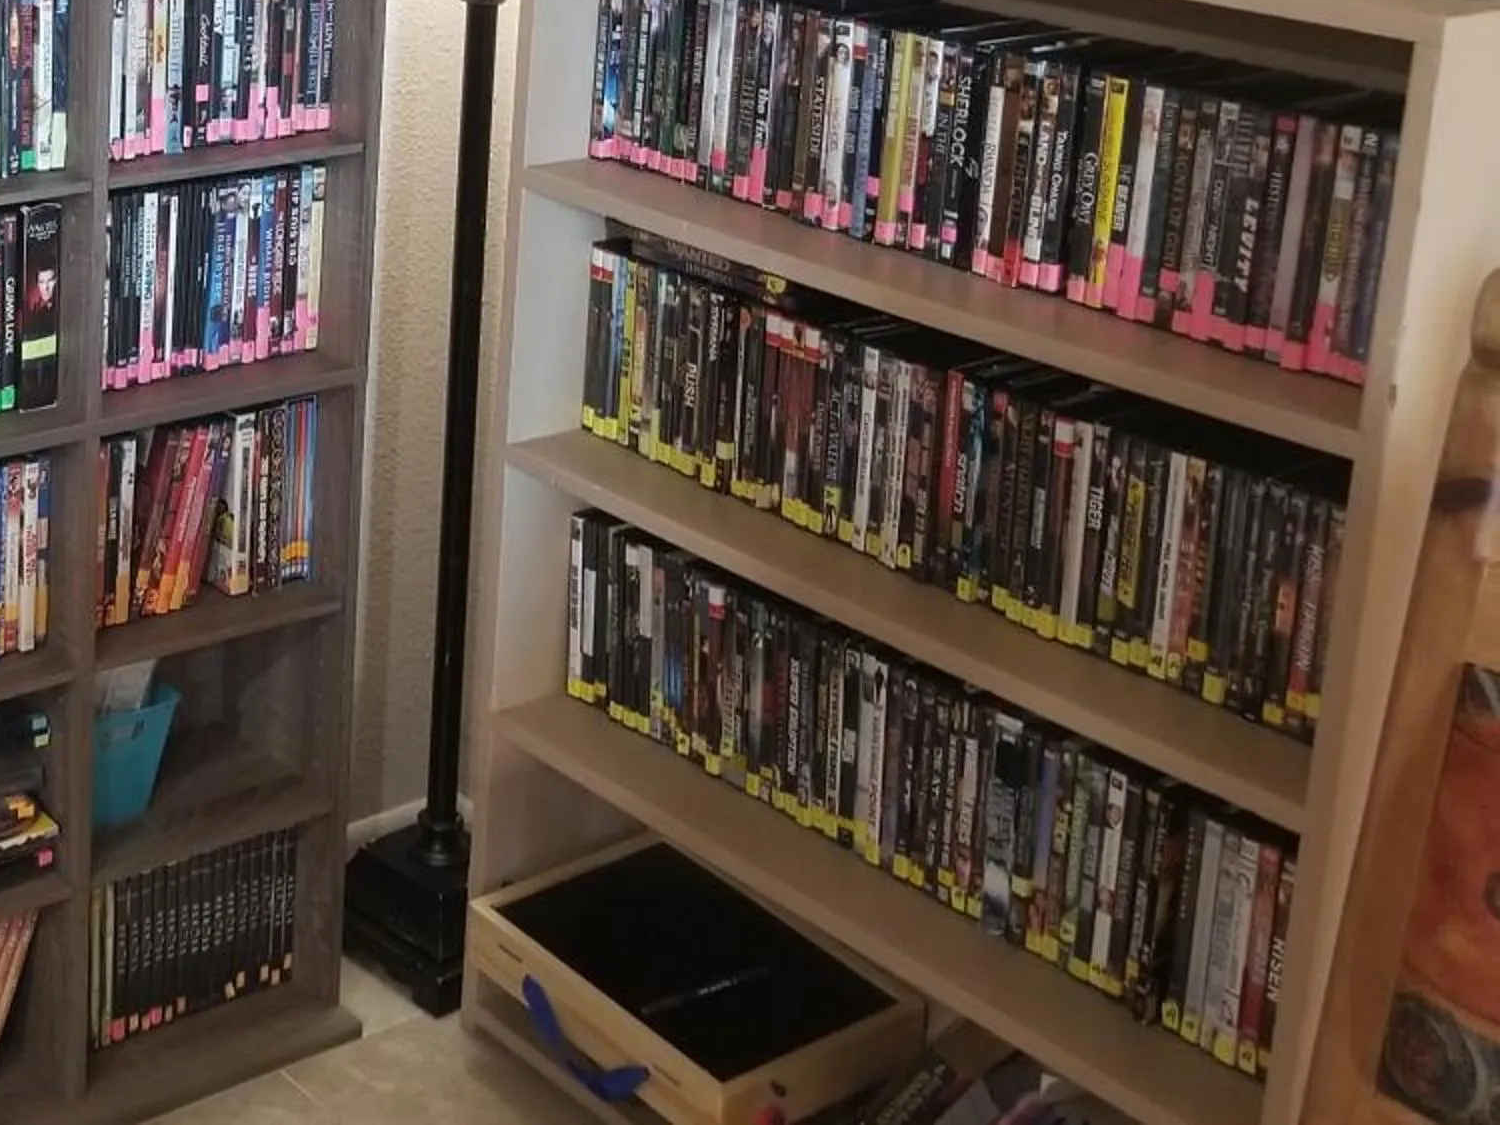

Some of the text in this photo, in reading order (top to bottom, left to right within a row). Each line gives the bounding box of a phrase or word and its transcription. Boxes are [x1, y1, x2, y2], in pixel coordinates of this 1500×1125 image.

[755, 87, 770, 114] the
[809, 75, 825, 158] STATESIDE
[950, 75, 971, 168] SHERLOCK
[1026, 120, 1052, 238] LAND BLIN
[1048, 130, 1069, 221] TAKING CHANCE
[1078, 152, 1099, 224] GREY OWL
[1113, 184, 1129, 232] BEAVER
[1235, 196, 1260, 292] LEVITY
[3, 277, 17, 354] GRIMM LOVE
[683, 362, 698, 408] PUSH
[952, 451, 969, 514] snatch
[1086, 485, 1105, 530] TIGER
[788, 657, 800, 706] SUPER
[1267, 937, 1288, 1004] RISEN
